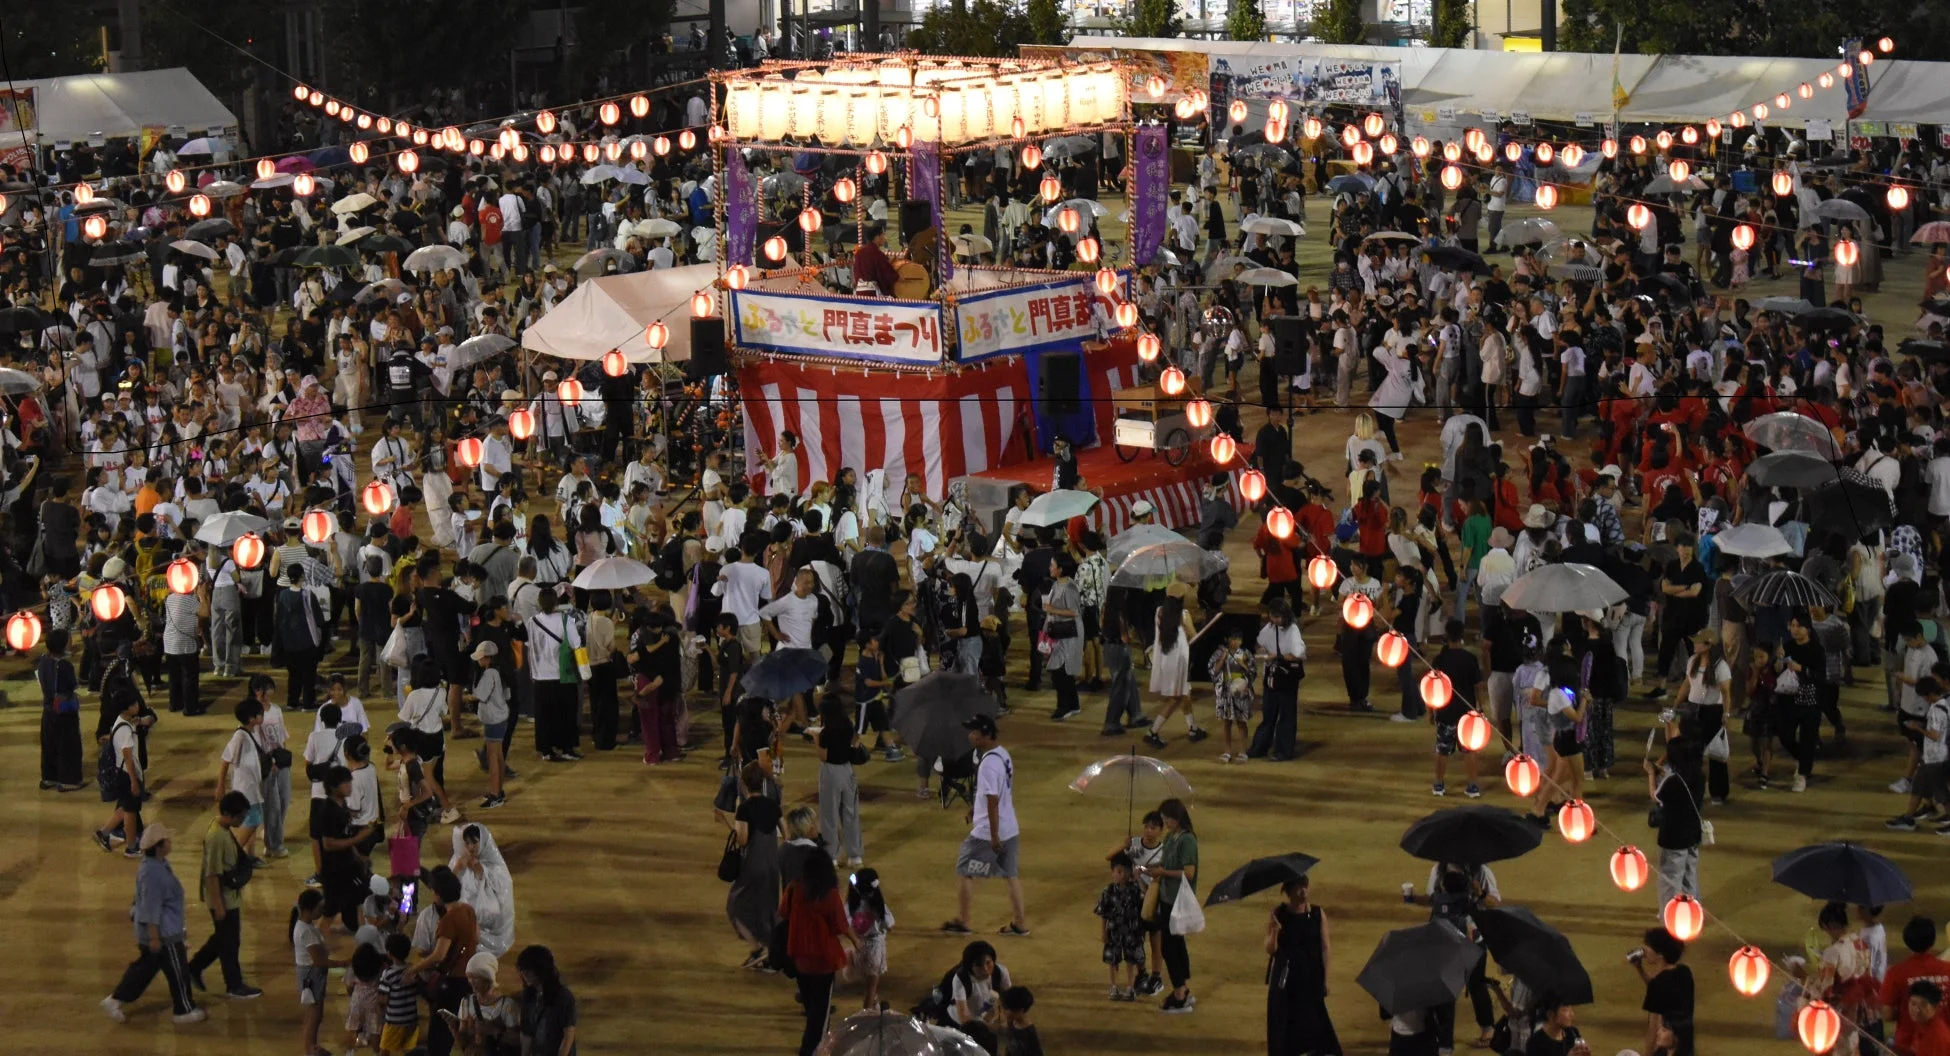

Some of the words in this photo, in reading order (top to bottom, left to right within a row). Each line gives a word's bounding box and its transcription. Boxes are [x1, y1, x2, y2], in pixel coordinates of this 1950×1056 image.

[1250, 65, 1264, 75] WE
[1325, 64, 1339, 73] WE
[1246, 81, 1261, 93] WE
[1325, 90, 1338, 99] WE
[743, 303, 939, 353] ふるさと門真まつり
